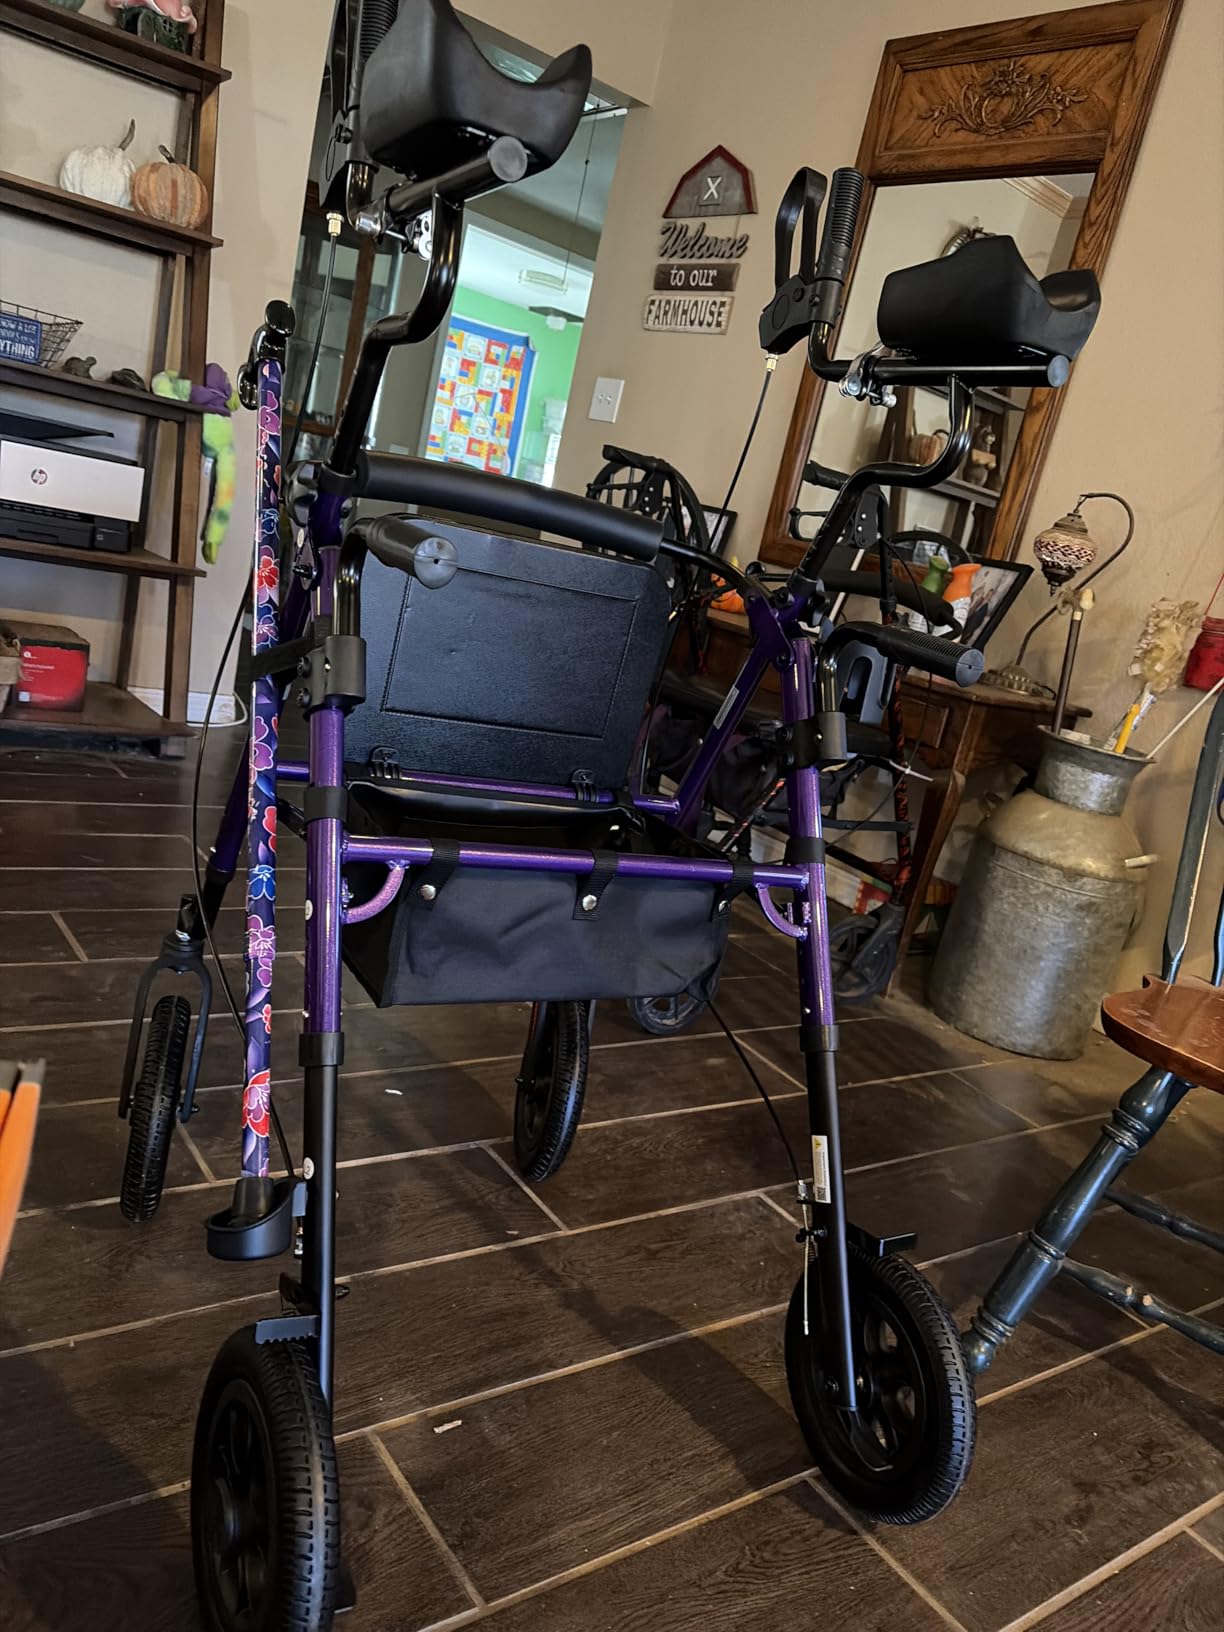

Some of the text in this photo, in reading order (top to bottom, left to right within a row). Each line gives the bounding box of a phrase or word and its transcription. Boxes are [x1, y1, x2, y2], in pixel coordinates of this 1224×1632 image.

[659, 222, 749, 259] Welcome
[670, 265, 717, 286] to our
[646, 300, 726, 328] FARMHOUSE
